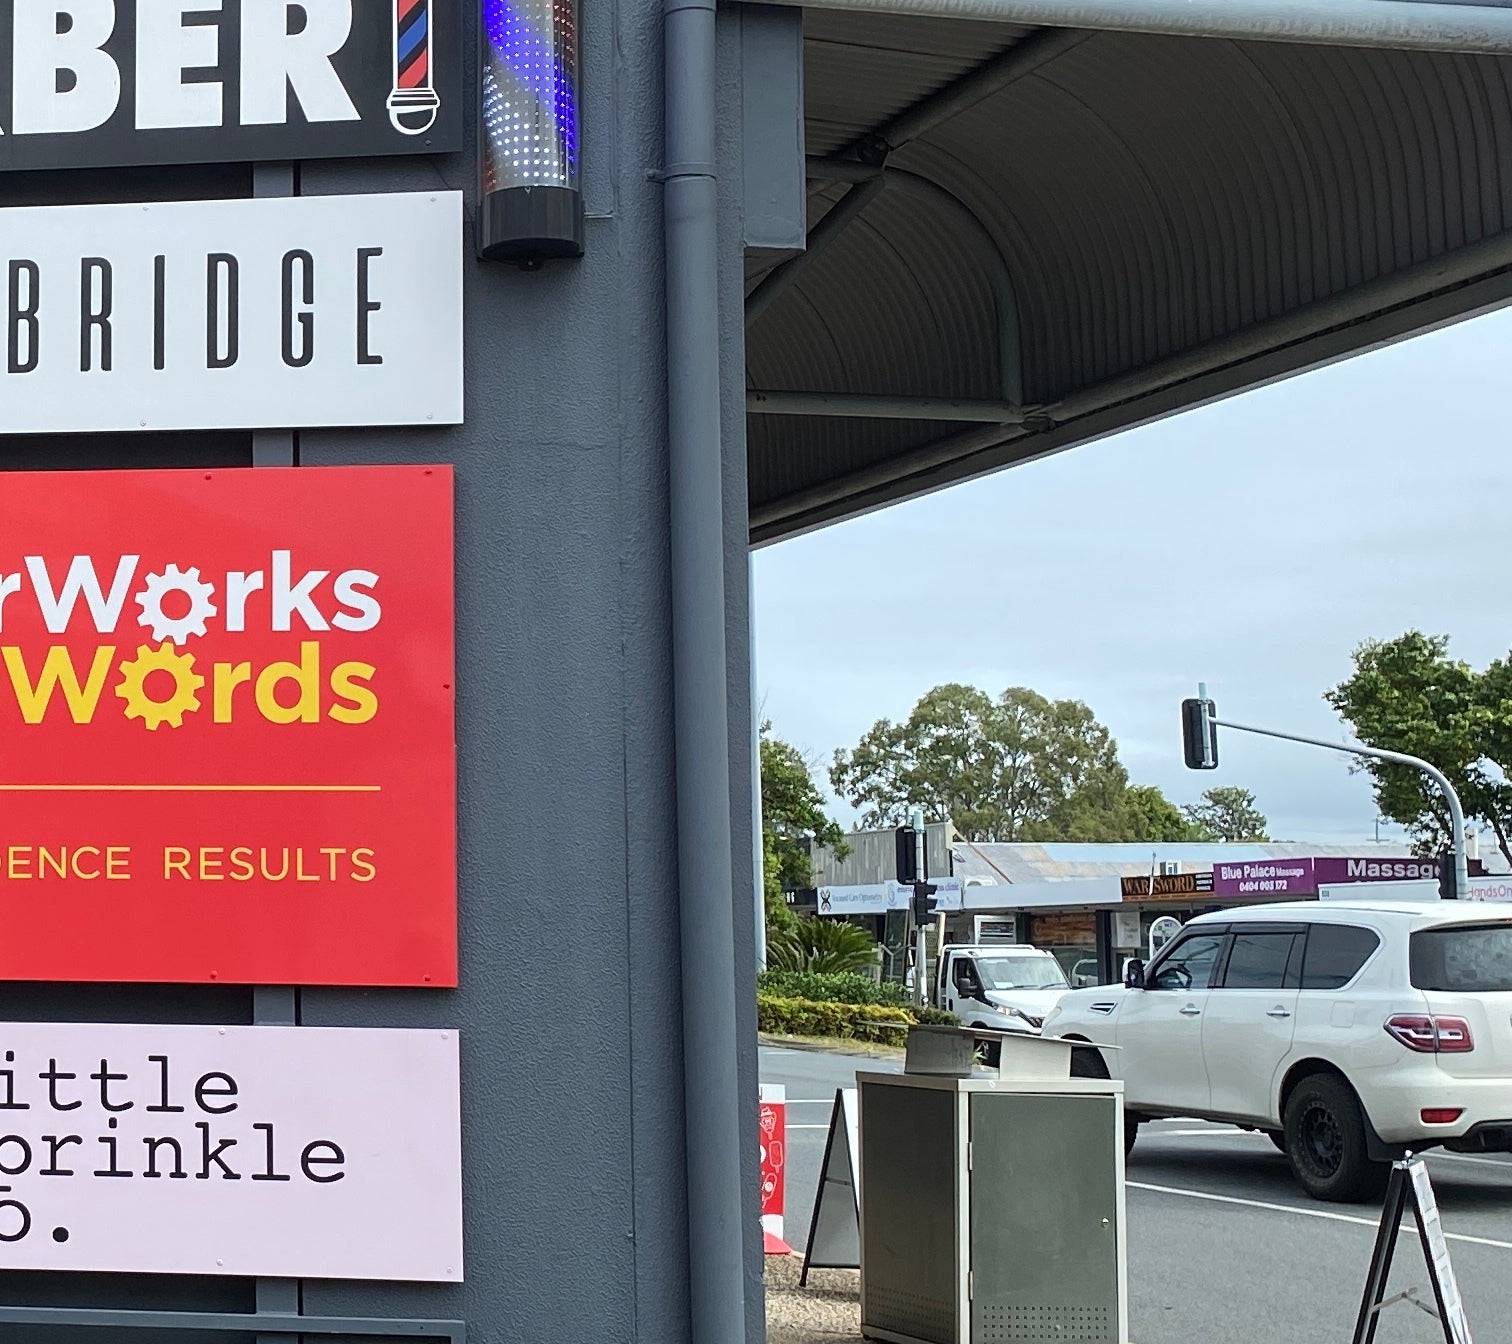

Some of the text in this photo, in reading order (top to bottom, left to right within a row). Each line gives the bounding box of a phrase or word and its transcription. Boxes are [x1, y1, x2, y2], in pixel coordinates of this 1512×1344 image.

[7, 247, 383, 374] BRIDGE
[164, 846, 376, 882] RESULTS
[1221, 864, 1305, 880] Blue Palace Massage
[1153, 875, 1194, 893] SWORD
[1239, 881, 1259, 892] 0404
